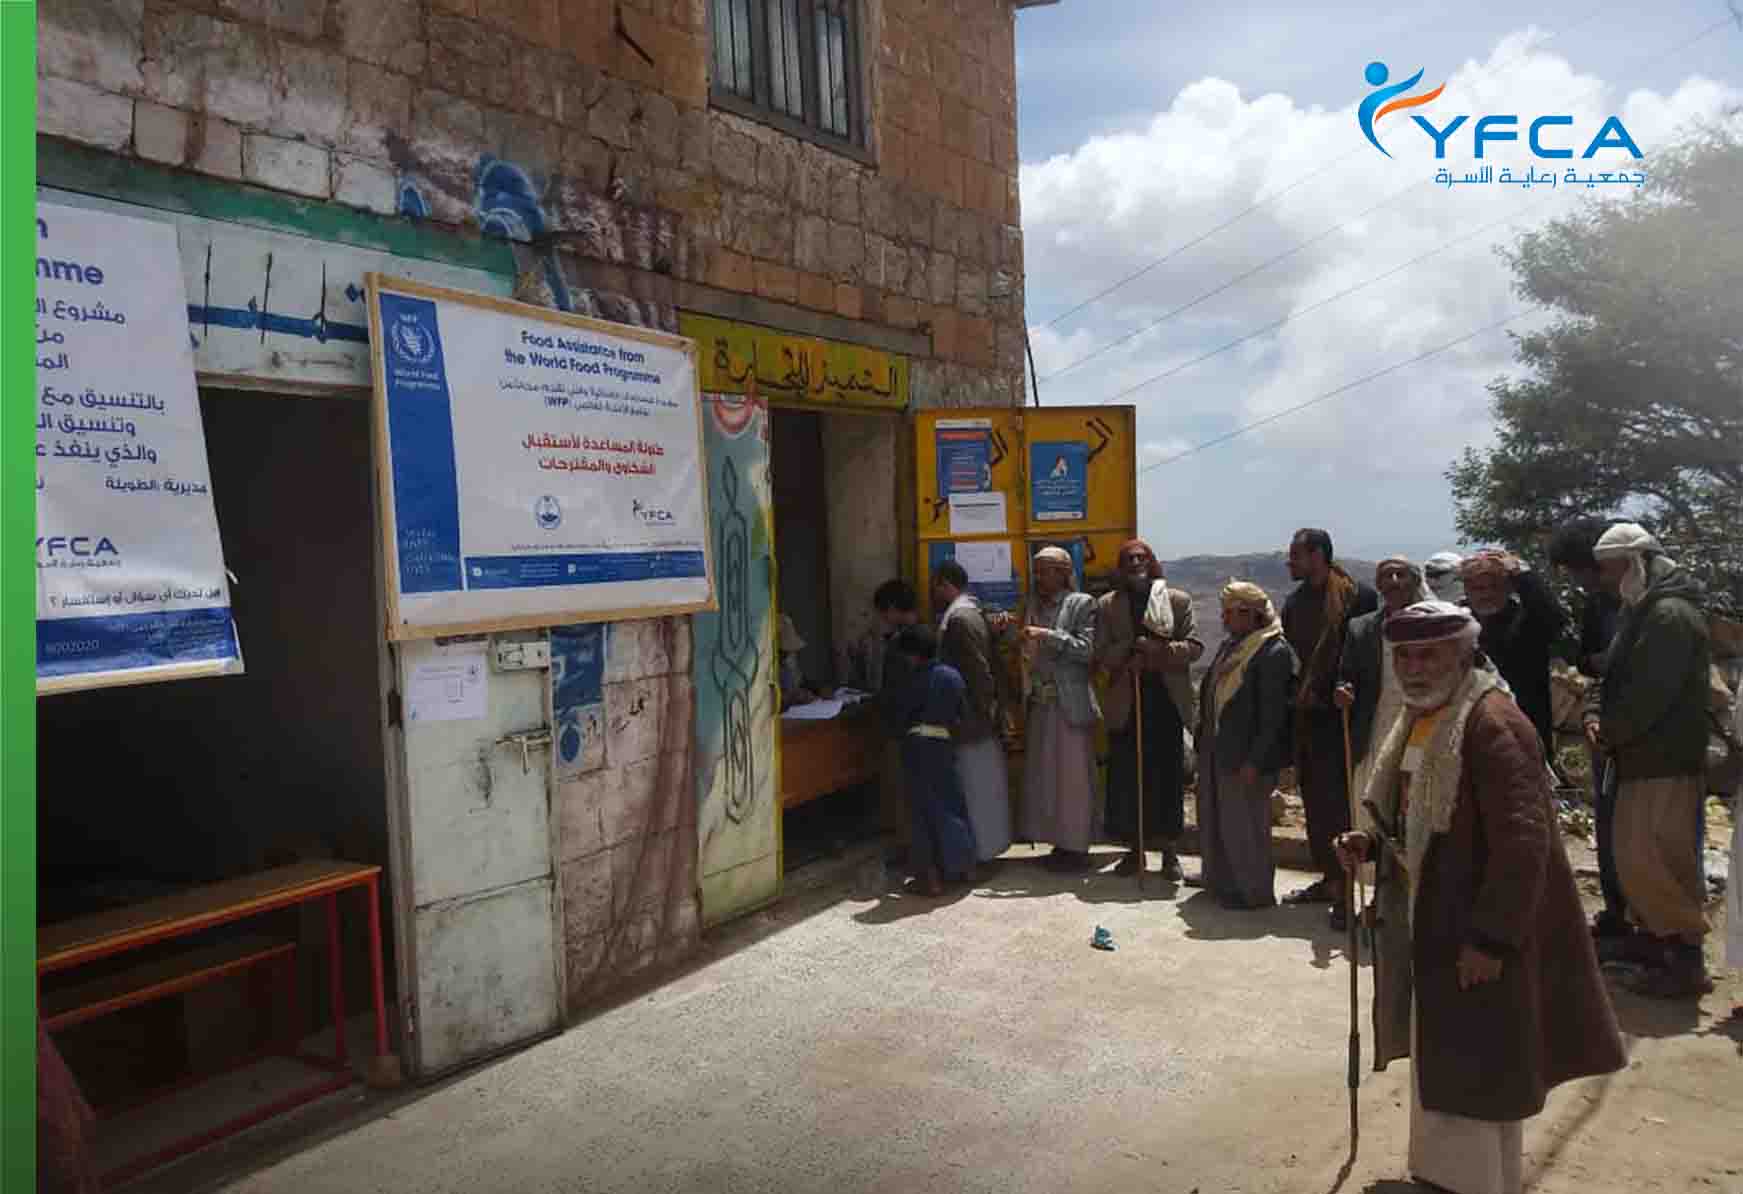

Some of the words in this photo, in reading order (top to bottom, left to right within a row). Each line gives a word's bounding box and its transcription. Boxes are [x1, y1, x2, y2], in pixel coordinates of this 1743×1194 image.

[53, 300, 125, 324] مشروع
[521, 330, 554, 348] Food
[618, 348, 645, 364] from
[504, 348, 526, 364] the
[529, 351, 567, 370] World
[569, 357, 601, 374] Food
[41, 386, 74, 406] مع
[80, 388, 165, 416] بالتنسيق
[58, 414, 135, 437] وتنسيق
[53, 440, 101, 462] ينفذ
[105, 442, 158, 468] والذي
